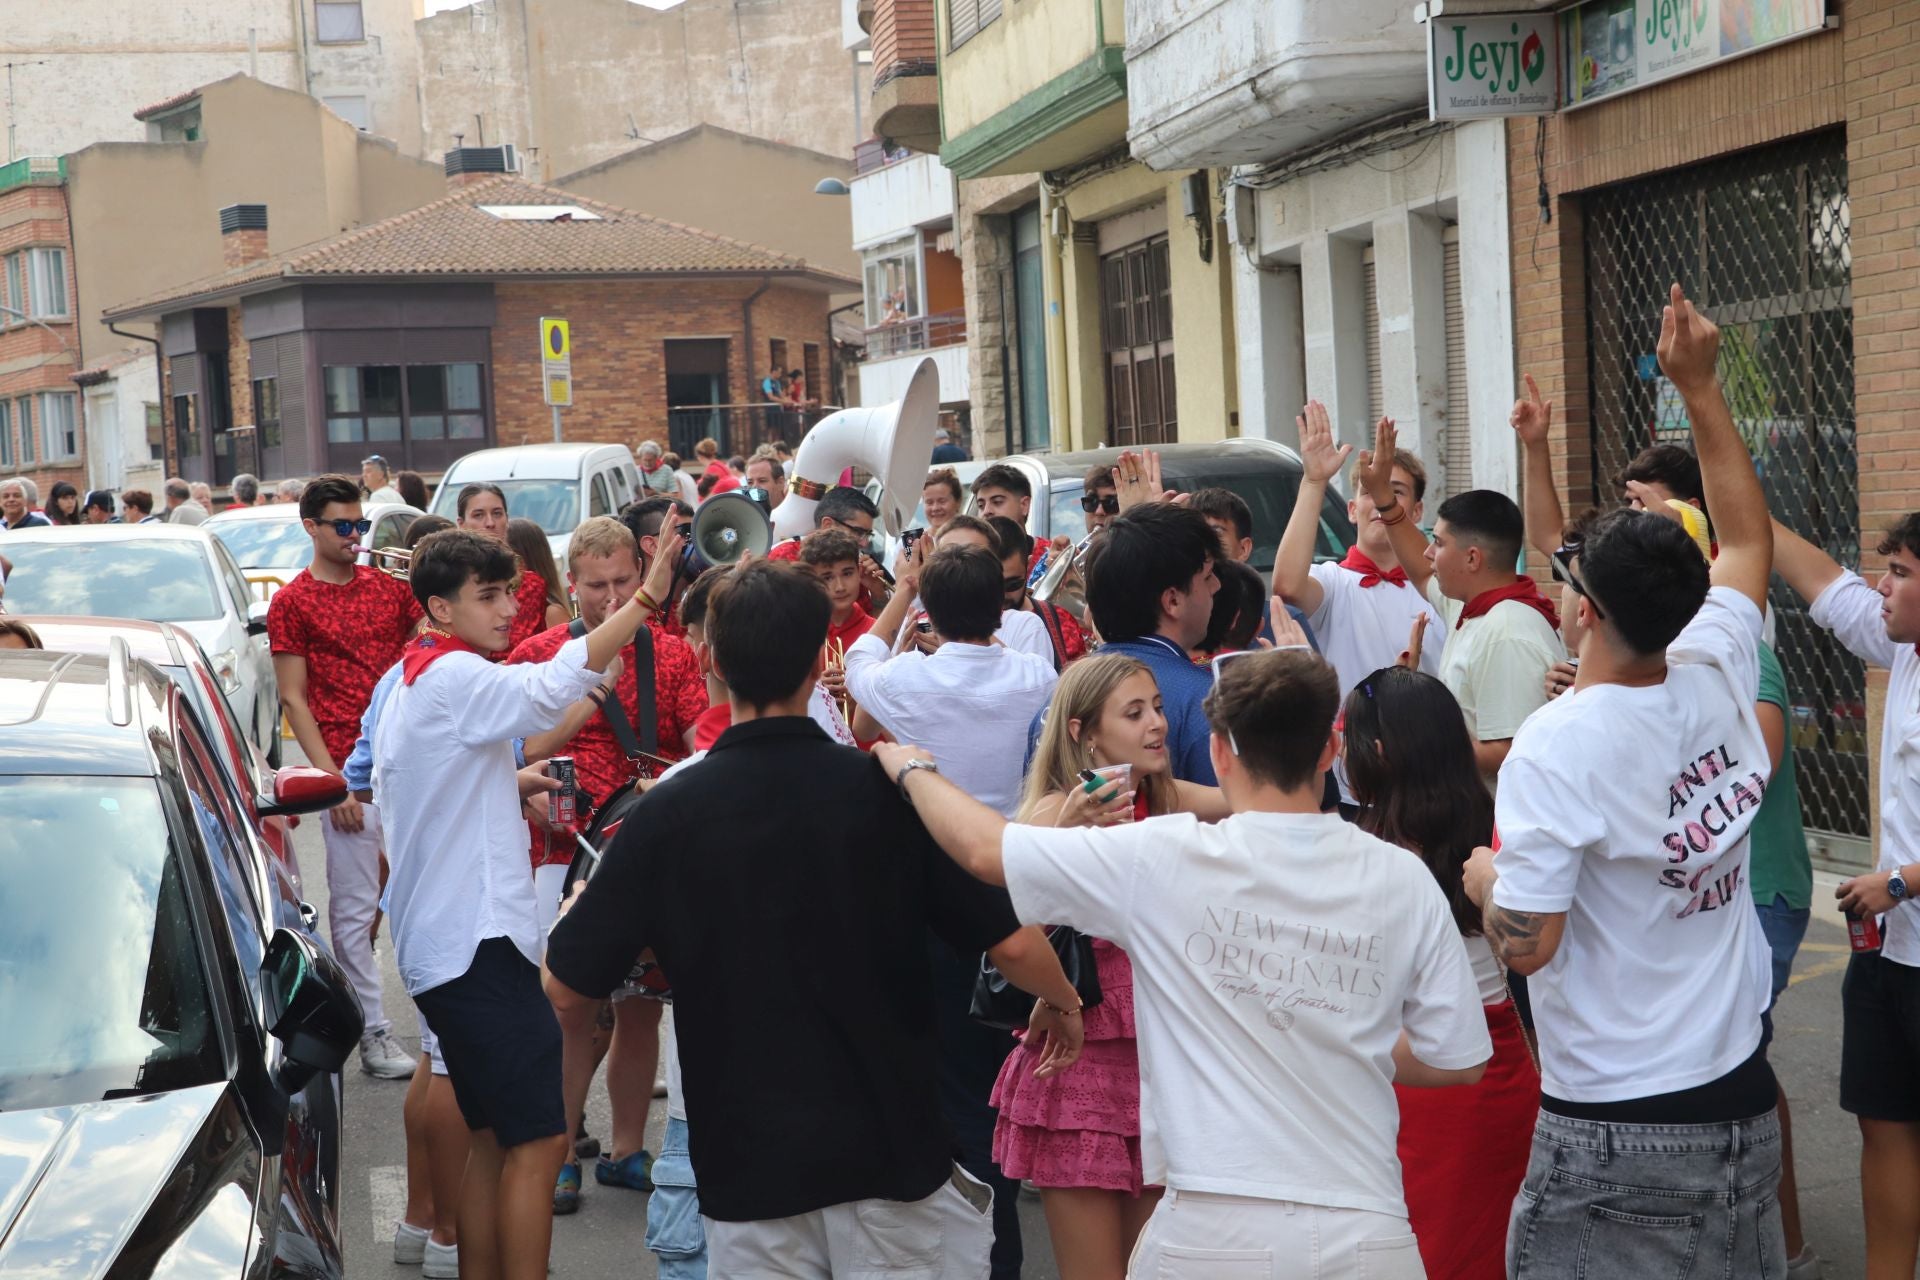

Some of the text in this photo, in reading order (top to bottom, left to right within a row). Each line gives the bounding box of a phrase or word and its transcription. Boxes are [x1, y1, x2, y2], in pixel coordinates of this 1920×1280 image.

[1646, 0, 1708, 52] Jeyjo
[1445, 21, 1545, 94] Jeyjo
[1449, 95, 1479, 108] Material
[1481, 95, 1488, 106] de
[1489, 94, 1512, 106] oficina
[1201, 905, 1383, 963] NEW TIME
[1184, 930, 1385, 999] ORIGINALS
[1212, 972, 1262, 999] Temple
[1264, 987, 1283, 1009] of
